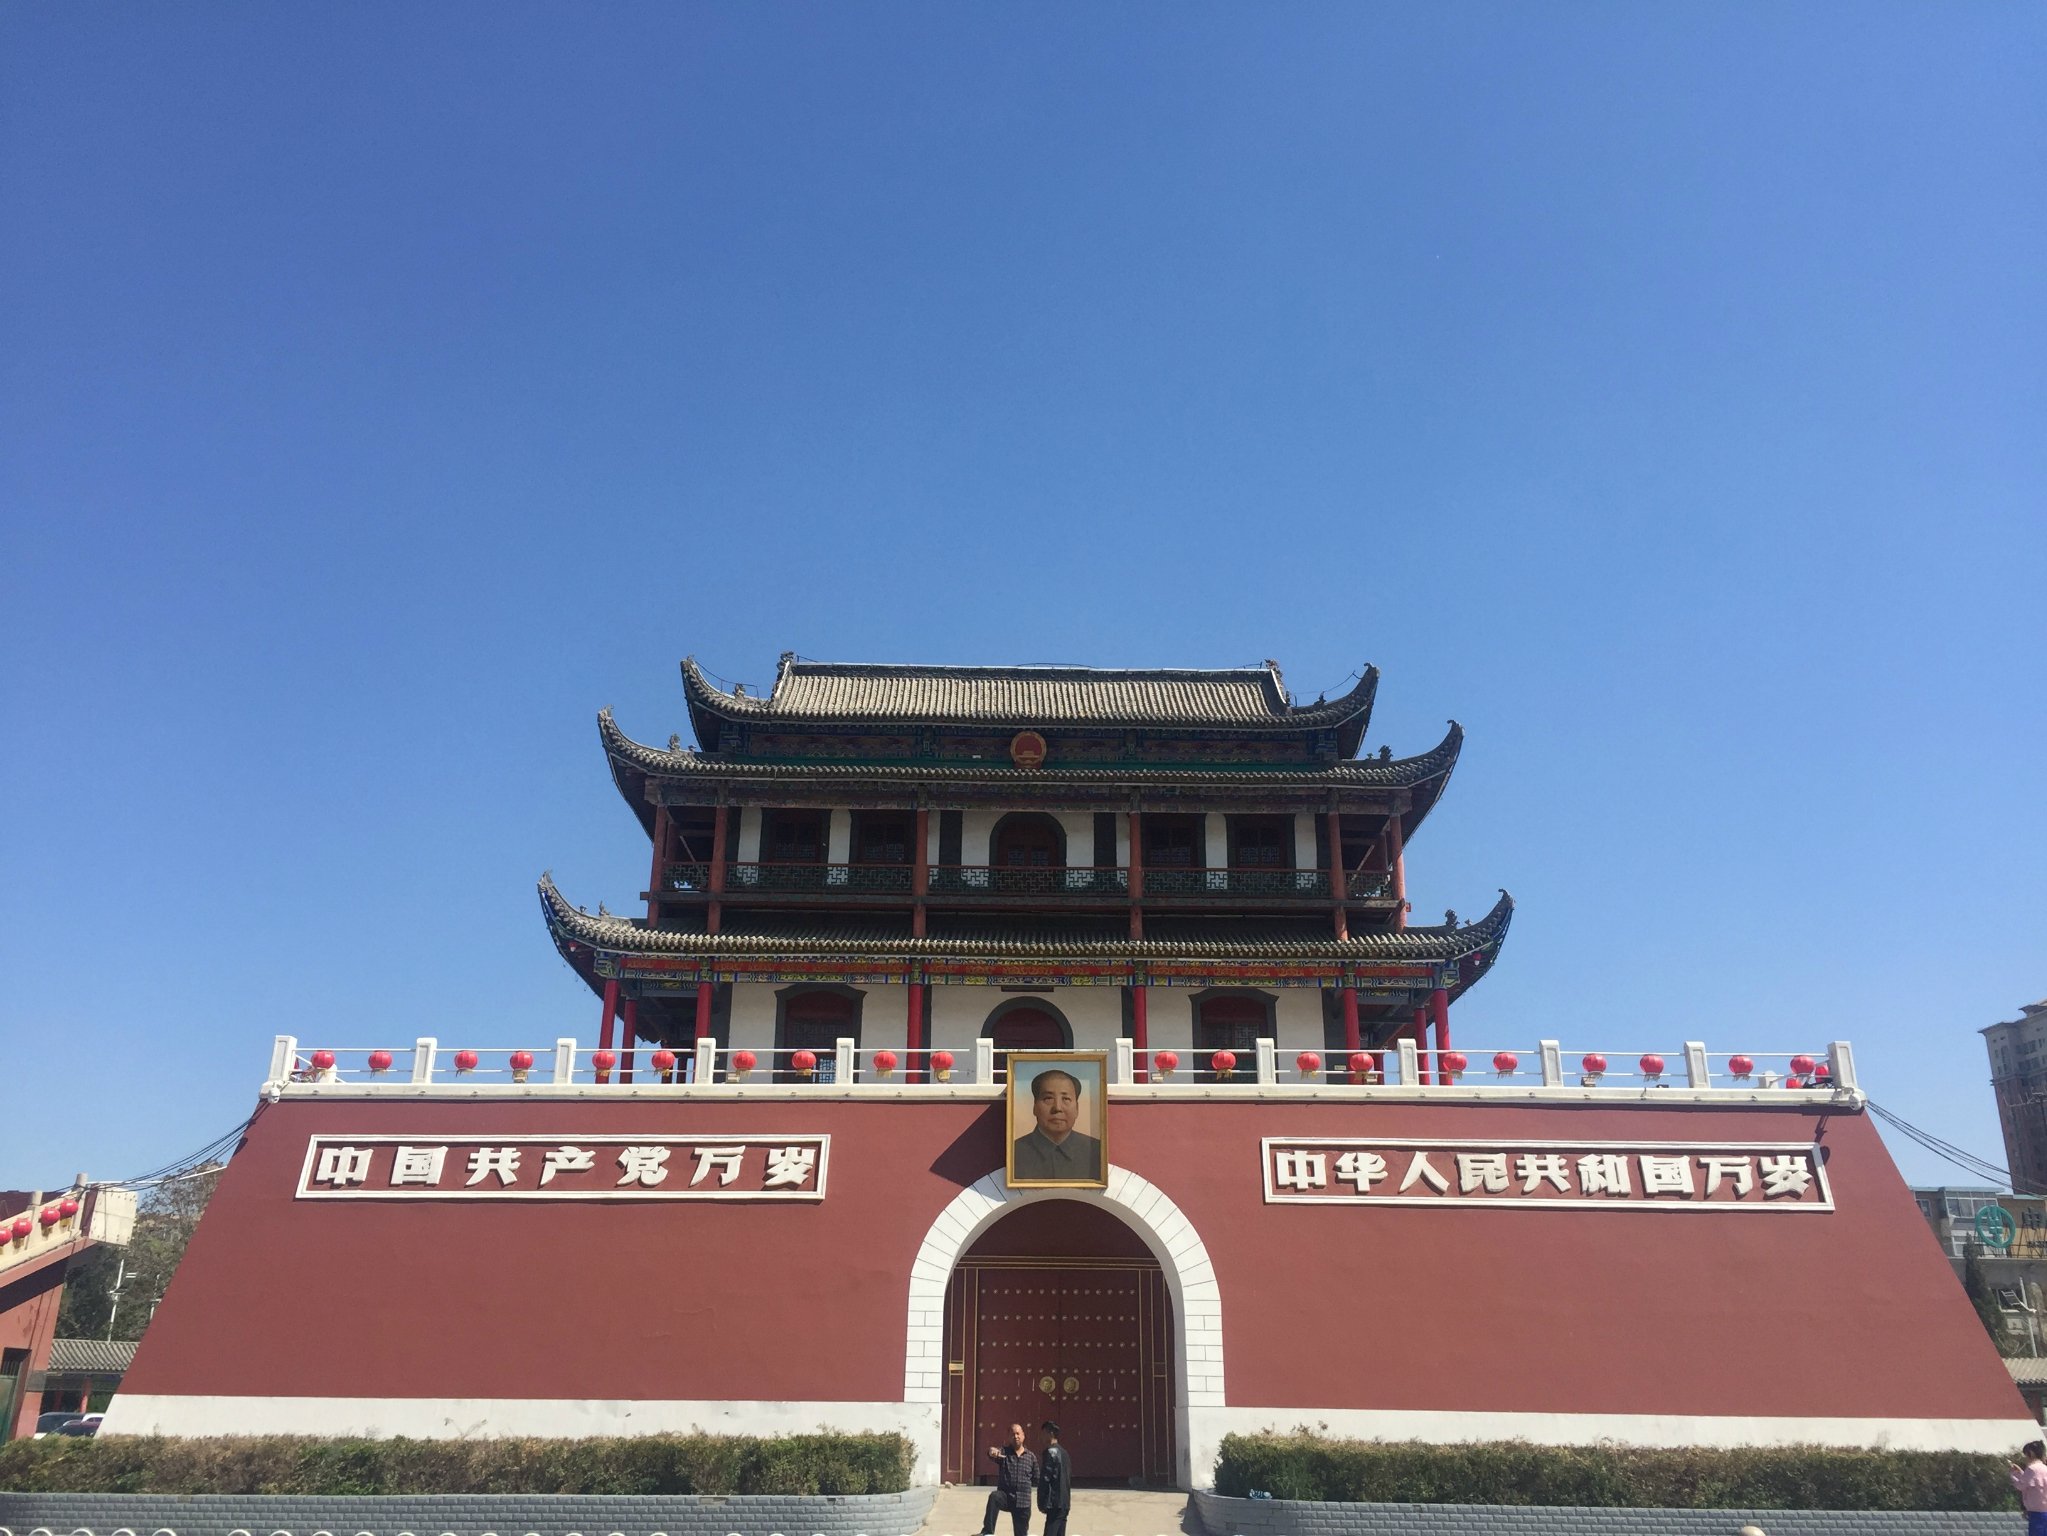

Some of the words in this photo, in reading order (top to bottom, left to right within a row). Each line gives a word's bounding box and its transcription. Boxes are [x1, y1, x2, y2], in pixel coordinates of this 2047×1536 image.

[316, 1145, 816, 1186] 中国共产党万岁
[1276, 1150, 1813, 1196] 中华人民共和国万岁
